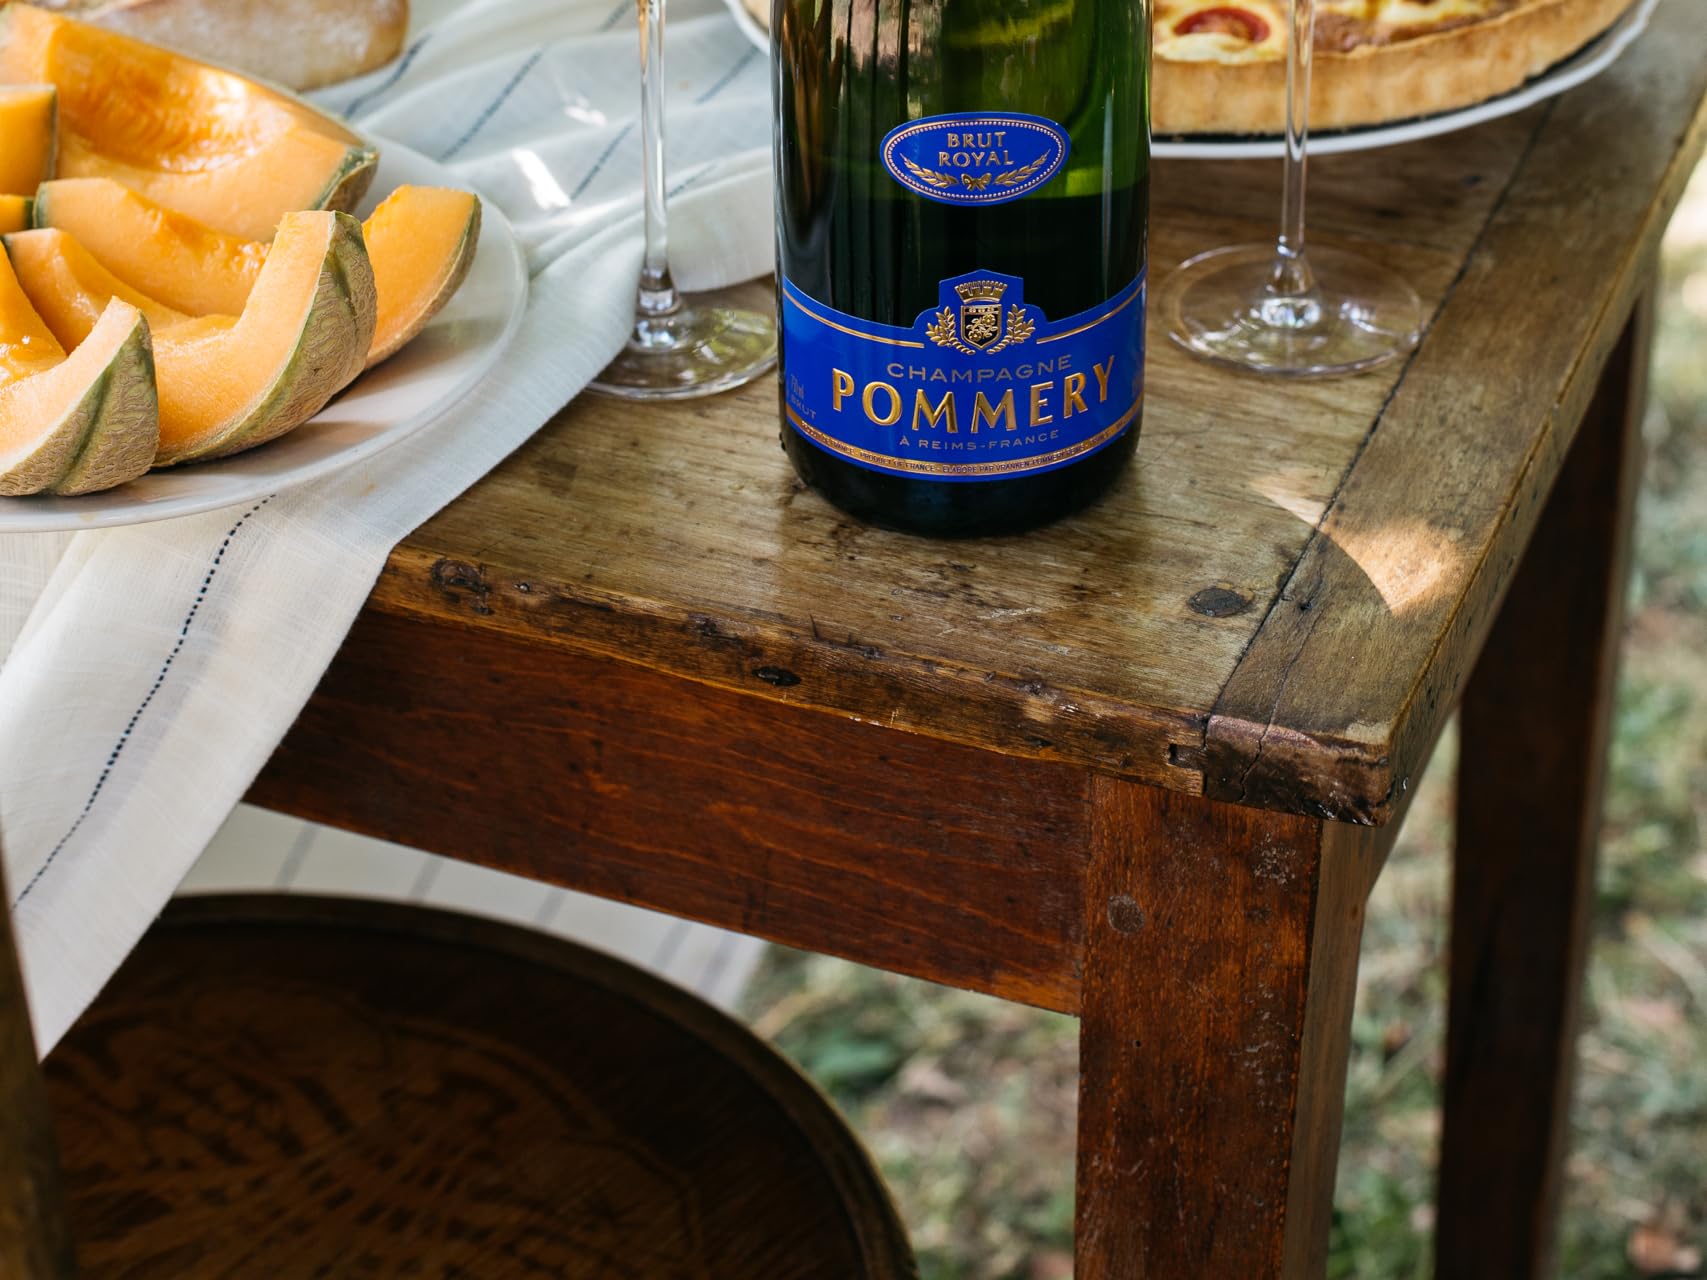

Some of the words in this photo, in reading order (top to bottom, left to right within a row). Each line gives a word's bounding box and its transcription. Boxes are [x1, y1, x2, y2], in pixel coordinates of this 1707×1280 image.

[947, 131, 1007, 148] BRUT
[938, 150, 1015, 168] ROYAL
[887, 354, 1073, 384] CHAMPAGNE
[832, 355, 1115, 434] POMMERY
